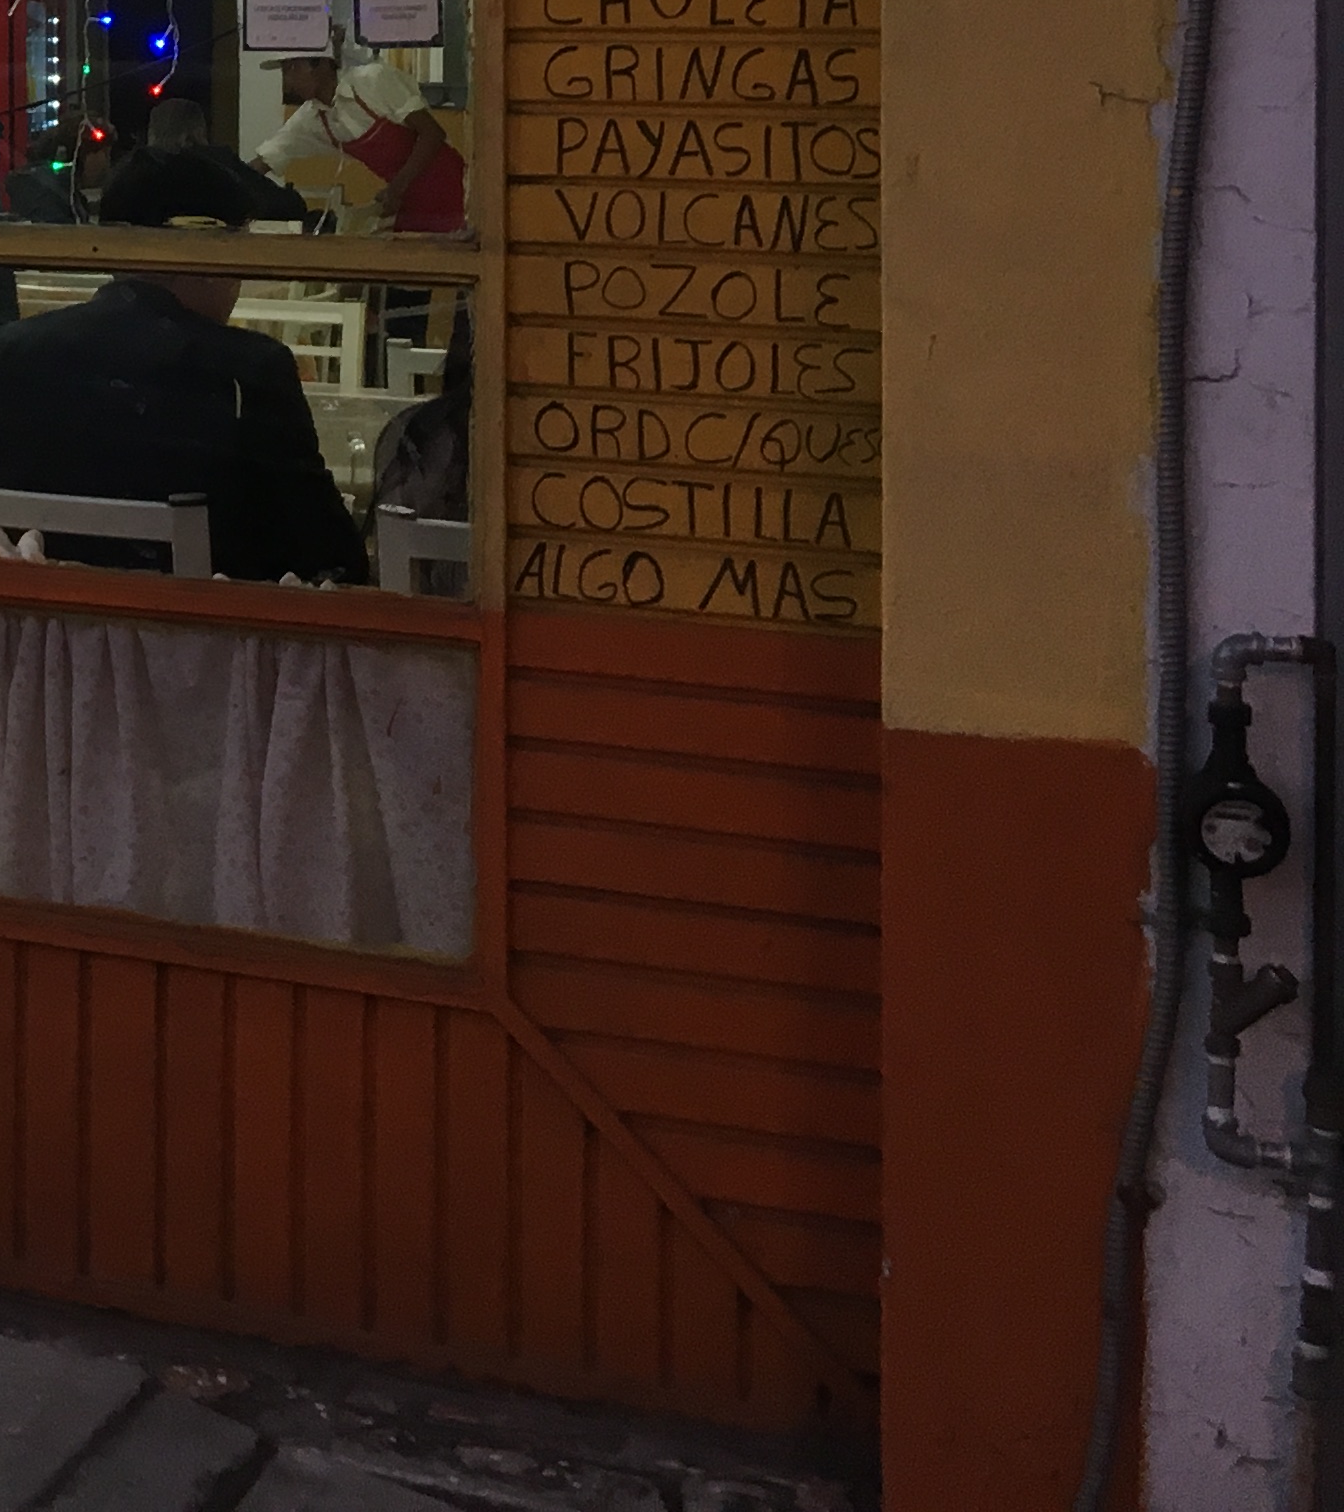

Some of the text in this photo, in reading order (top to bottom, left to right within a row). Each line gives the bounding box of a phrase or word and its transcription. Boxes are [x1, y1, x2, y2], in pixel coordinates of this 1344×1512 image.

[543, 45, 860, 106] GRINGAS
[556, 116, 881, 181] PAYASITOS
[554, 188, 879, 253] VOLCANES
[564, 260, 852, 329] POZOLE
[567, 331, 875, 400] FRIJOLES
[531, 472, 853, 548] COSTILLA
[514, 541, 858, 622] ALGO MAS
